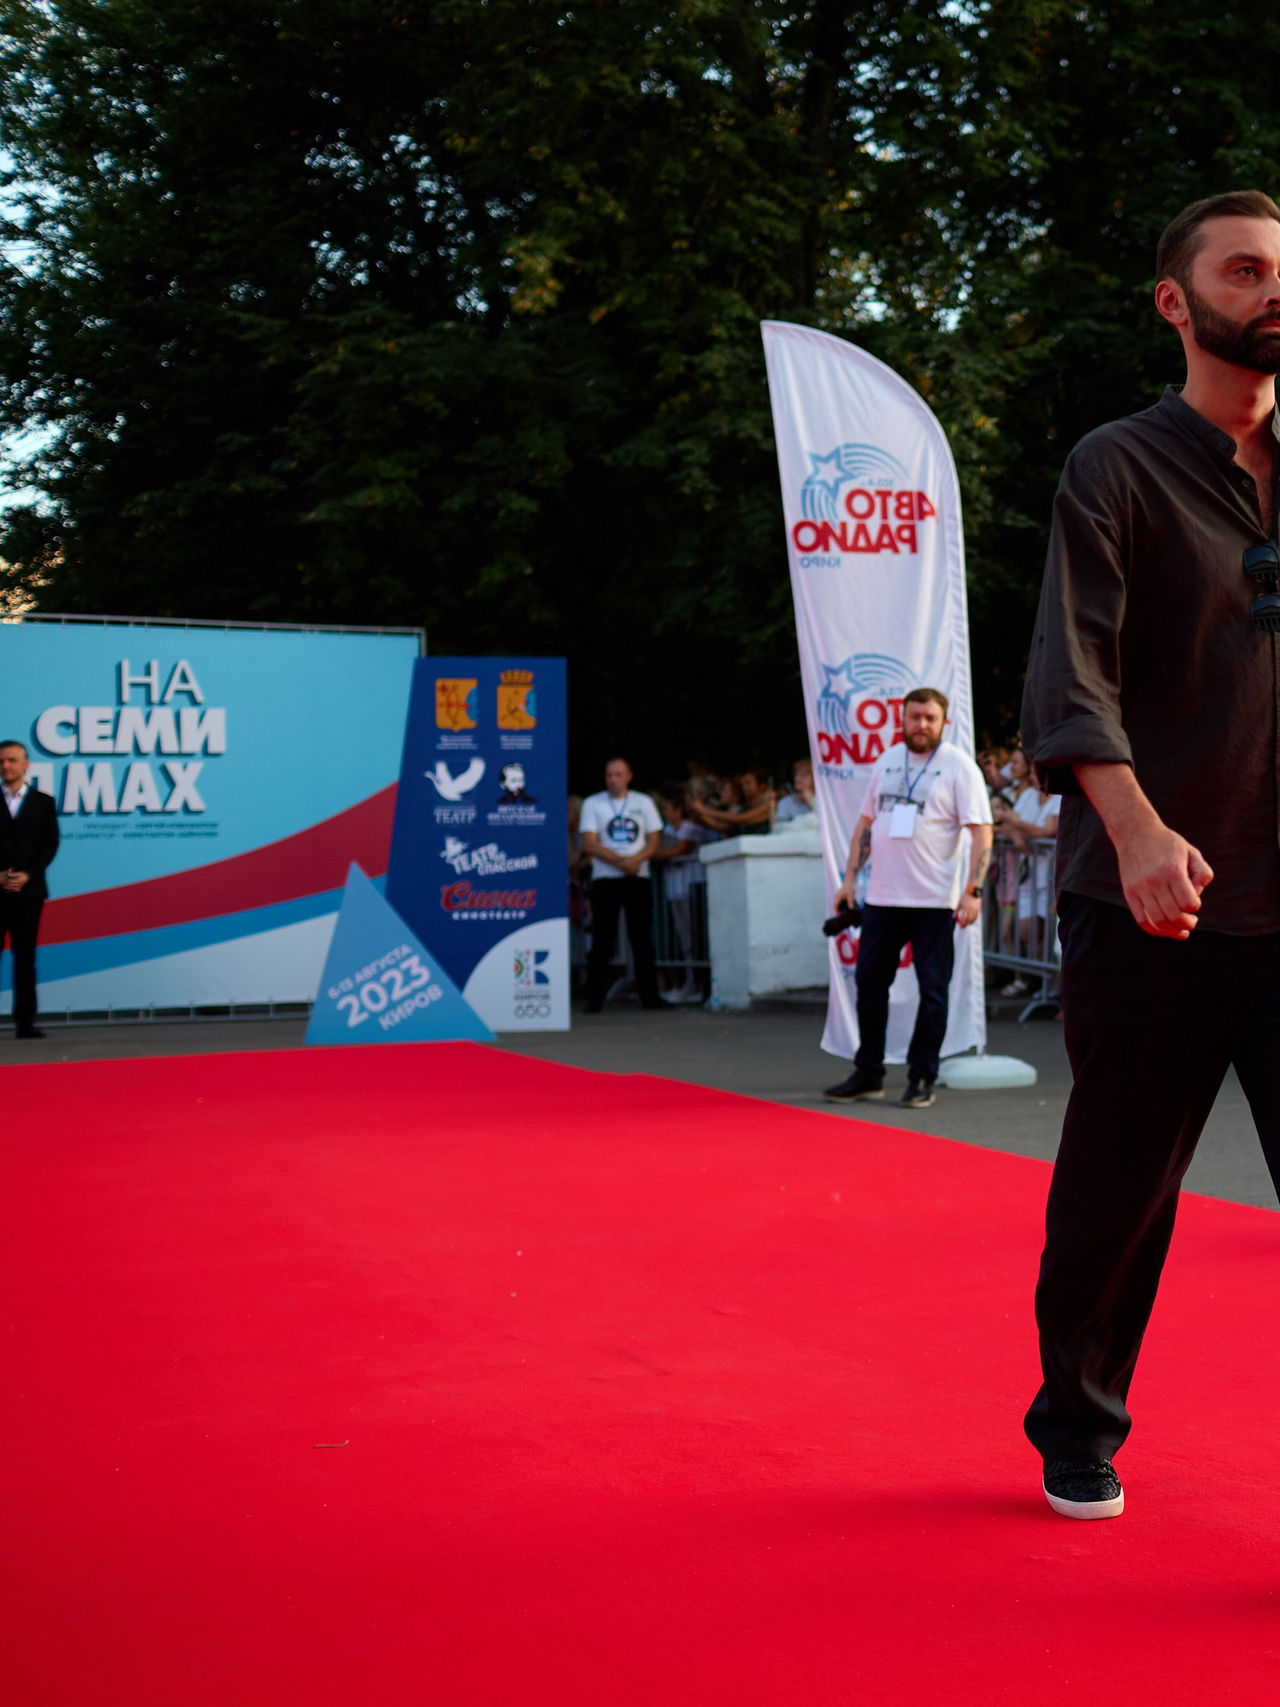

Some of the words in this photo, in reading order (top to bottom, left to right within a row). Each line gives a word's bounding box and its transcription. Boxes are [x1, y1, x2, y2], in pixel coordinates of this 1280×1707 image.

[120, 659, 205, 703] НА
[36, 705, 226, 755] СЕМИ
[26, 762, 206, 814] ЛМАХ
[453, 843, 498, 875] ТЕАТР
[336, 953, 431, 1028] 2023
[378, 983, 443, 1031] КИРОВ
